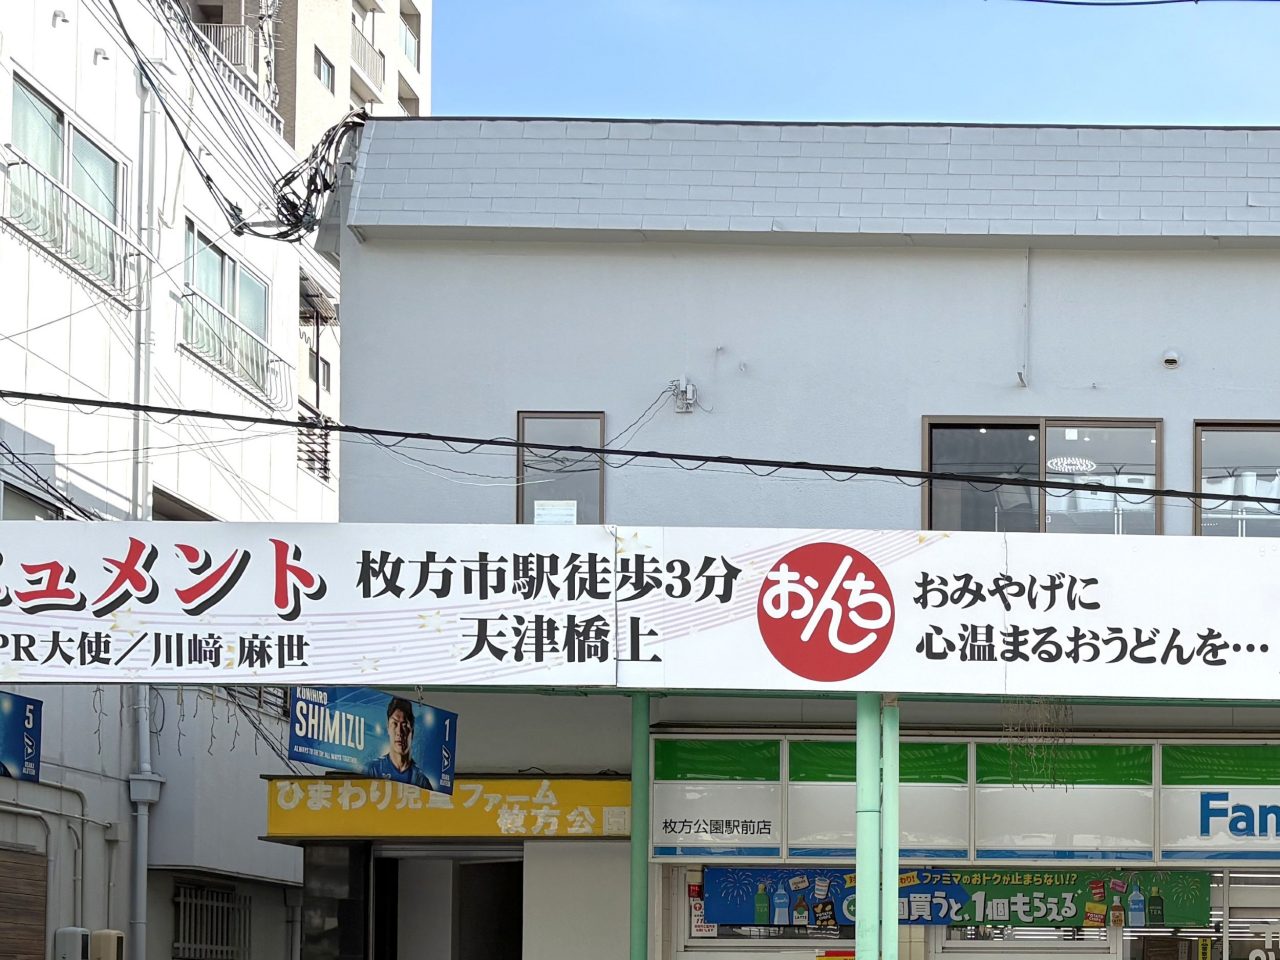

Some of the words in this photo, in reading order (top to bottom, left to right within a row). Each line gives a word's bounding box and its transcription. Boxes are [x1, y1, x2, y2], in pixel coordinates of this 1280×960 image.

[0, 536, 328, 621] ュメント
[355, 550, 742, 605] 枚方市駅徒歩3分
[913, 571, 1101, 611] おみやげに
[762, 554, 891, 654] おんち
[237, 633, 311, 669] 麻世
[460, 614, 663, 664] 天津橋上
[296, 686, 328, 705] KUNIHIRO
[24, 704, 34, 729] 5
[295, 701, 365, 750] SHIMIZU
[444, 718, 451, 742] 1
[662, 818, 772, 836] 枚方公園駅前店
